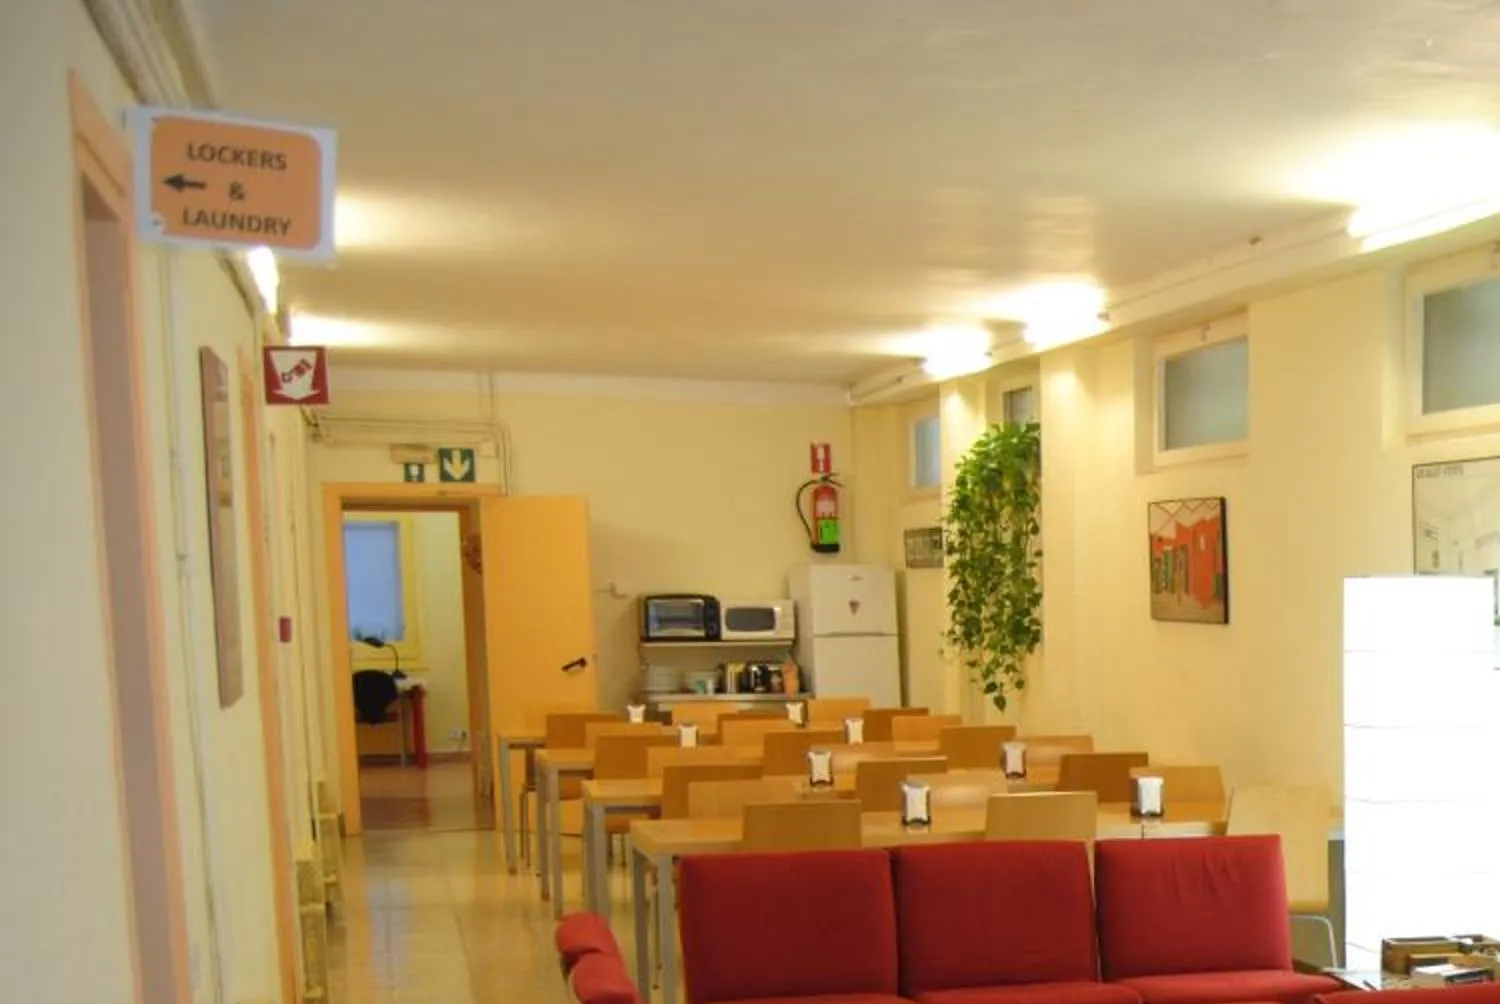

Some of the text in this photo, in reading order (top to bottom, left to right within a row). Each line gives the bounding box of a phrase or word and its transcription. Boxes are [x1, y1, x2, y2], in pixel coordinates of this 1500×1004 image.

[186, 143, 288, 171] LOCKERS
[228, 181, 245, 201] &
[182, 208, 292, 237] LAUNDRY
